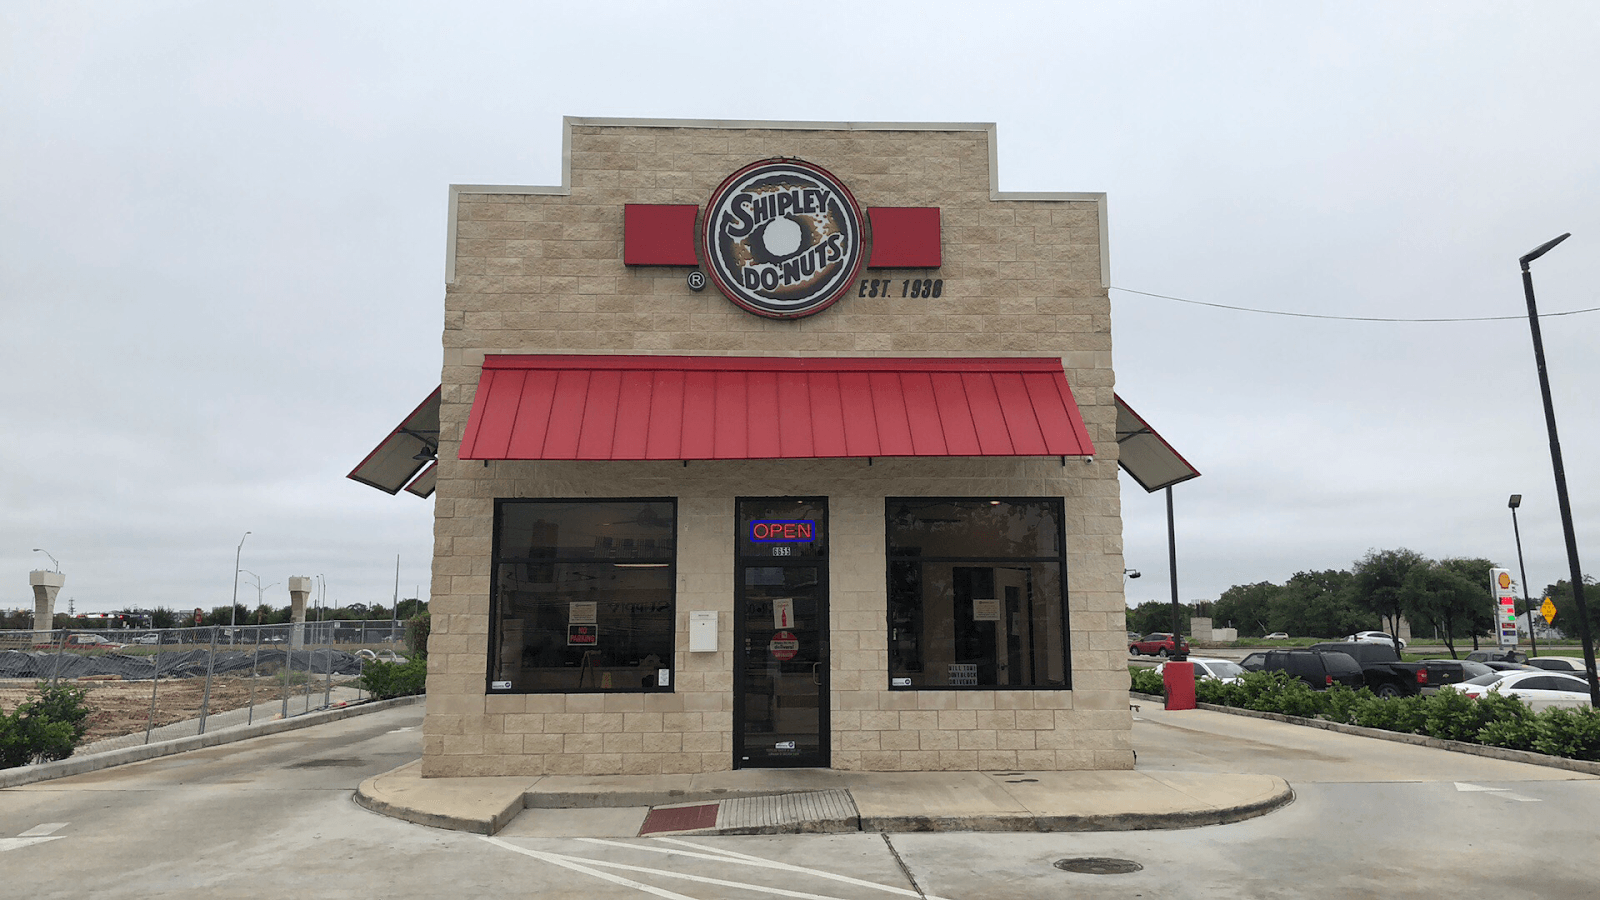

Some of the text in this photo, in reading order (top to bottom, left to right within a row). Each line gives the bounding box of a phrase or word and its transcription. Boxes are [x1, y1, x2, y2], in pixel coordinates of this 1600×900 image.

[727, 190, 831, 238] SHIPLEY
[743, 234, 841, 291] DO-NUTS
[858, 279, 892, 298] EST.
[753, 523, 811, 539] OPEN
[773, 547, 791, 556] 6655
